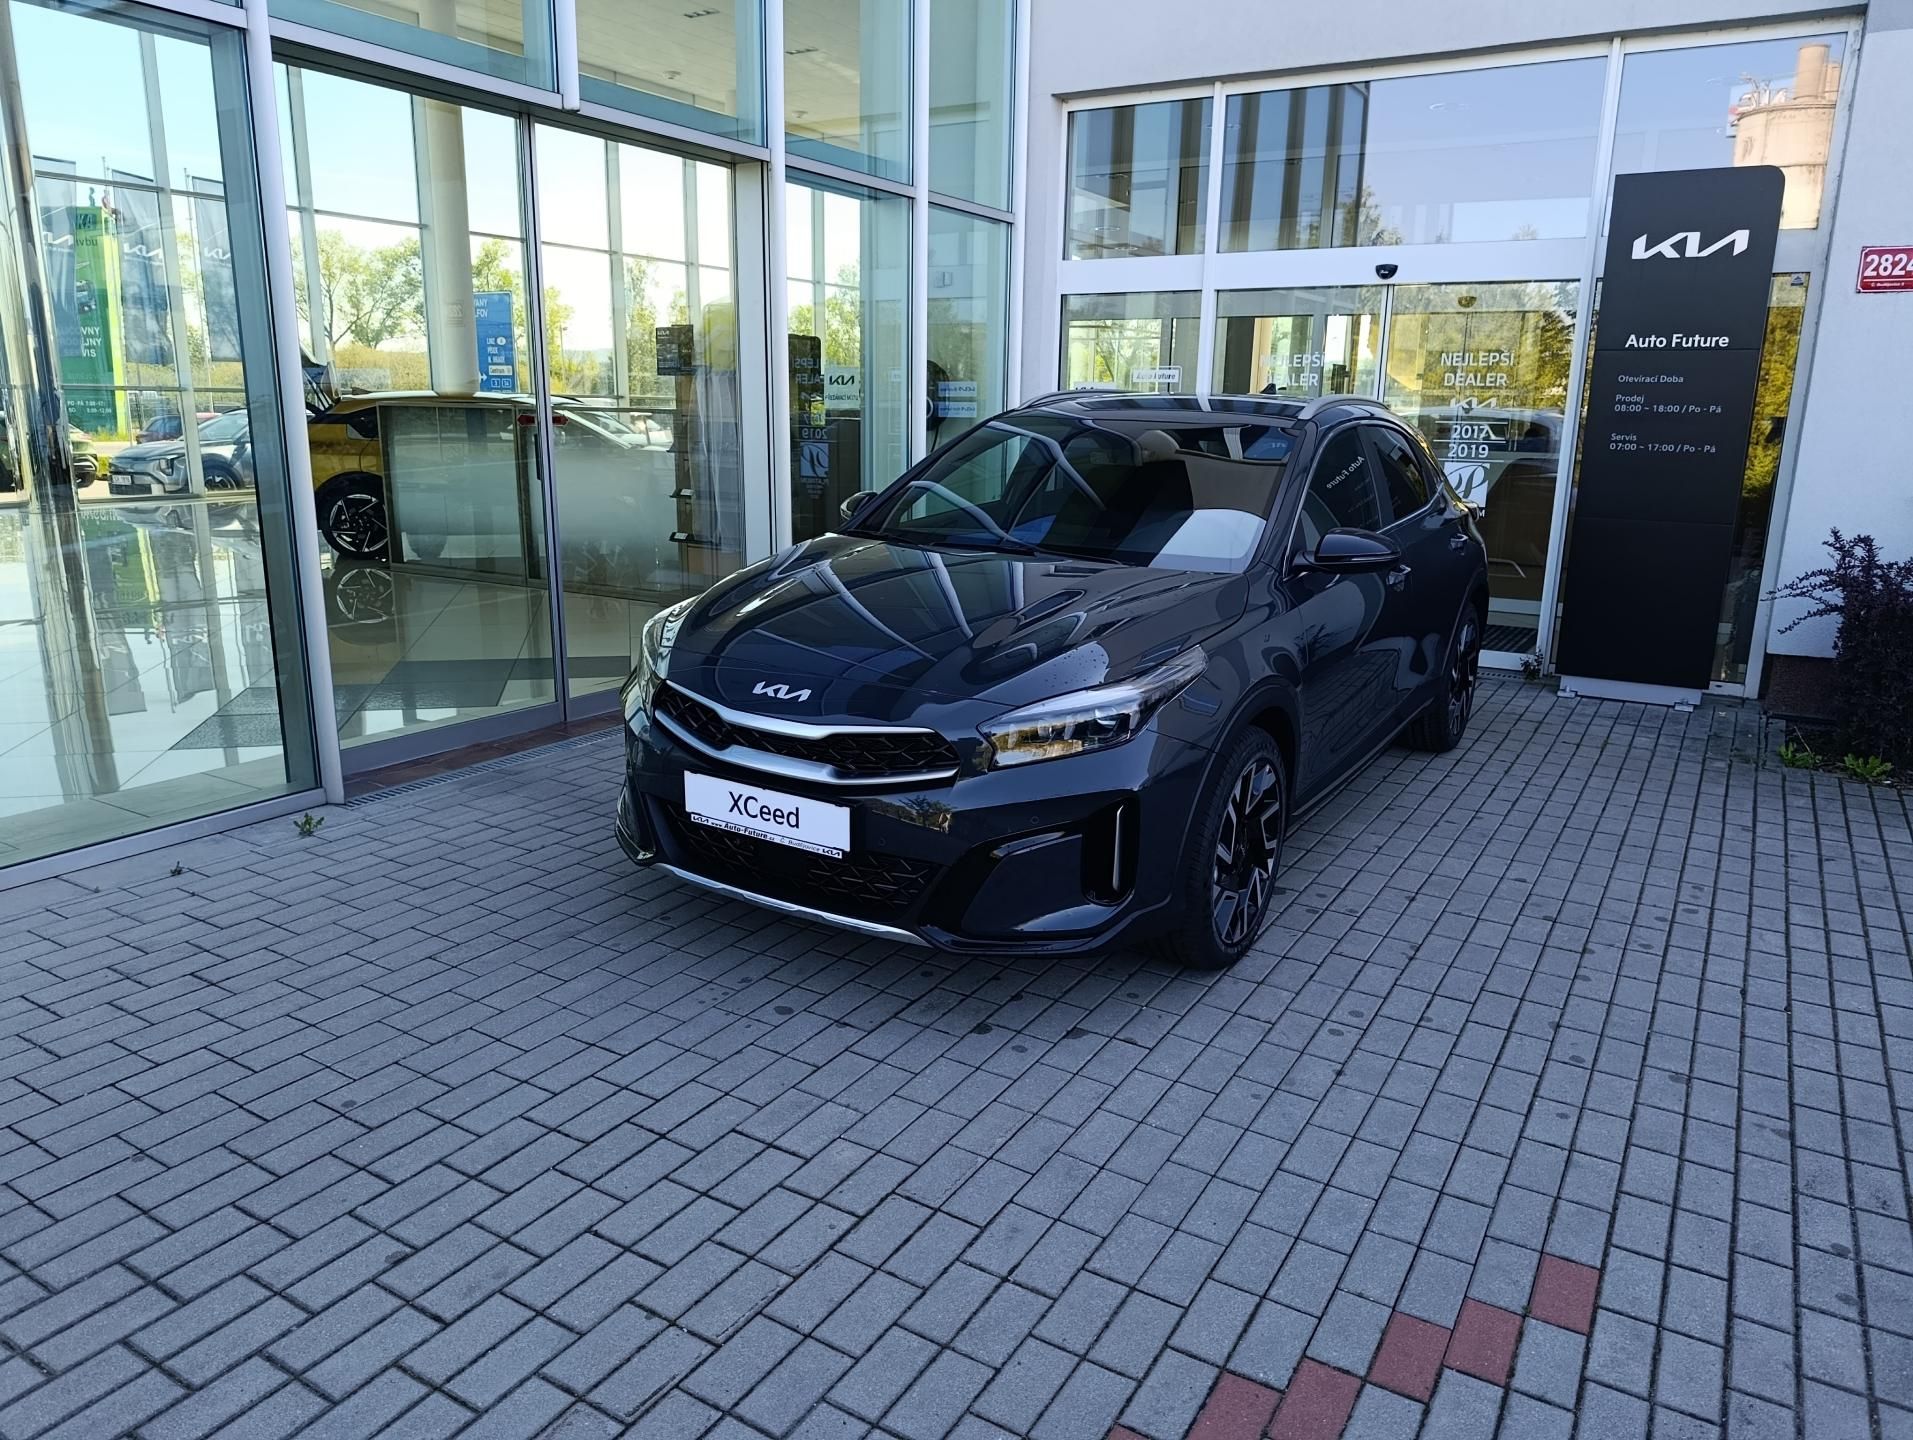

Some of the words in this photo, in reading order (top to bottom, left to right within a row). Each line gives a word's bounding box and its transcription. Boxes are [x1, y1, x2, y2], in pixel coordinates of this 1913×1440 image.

[1631, 229, 1750, 260] KIA
[1624, 333, 1667, 348] Auto
[1671, 333, 1729, 348] Future
[1441, 350, 1515, 367] NEJLEPŠÍ
[1444, 372, 1508, 387] DEALER
[1660, 375, 1684, 383] Doba
[1615, 394, 1644, 404] Prodej
[1614, 404, 1642, 412] 08:00
[1653, 405, 1680, 413] 18:00
[1688, 405, 1701, 413] Po
[1709, 405, 1722, 413] Pá
[1451, 424, 1489, 440] 2017
[1611, 433, 1637, 441] Servis
[1447, 443, 1489, 458] 2019
[1609, 442, 1637, 451] 07:00
[1648, 444, 1675, 452] 17:00
[1683, 445, 1696, 453] Po
[1704, 445, 1716, 453] Pá
[752, 681, 812, 702] KIA
[728, 790, 800, 829] XCeed
[822, 848, 841, 857] KIA
